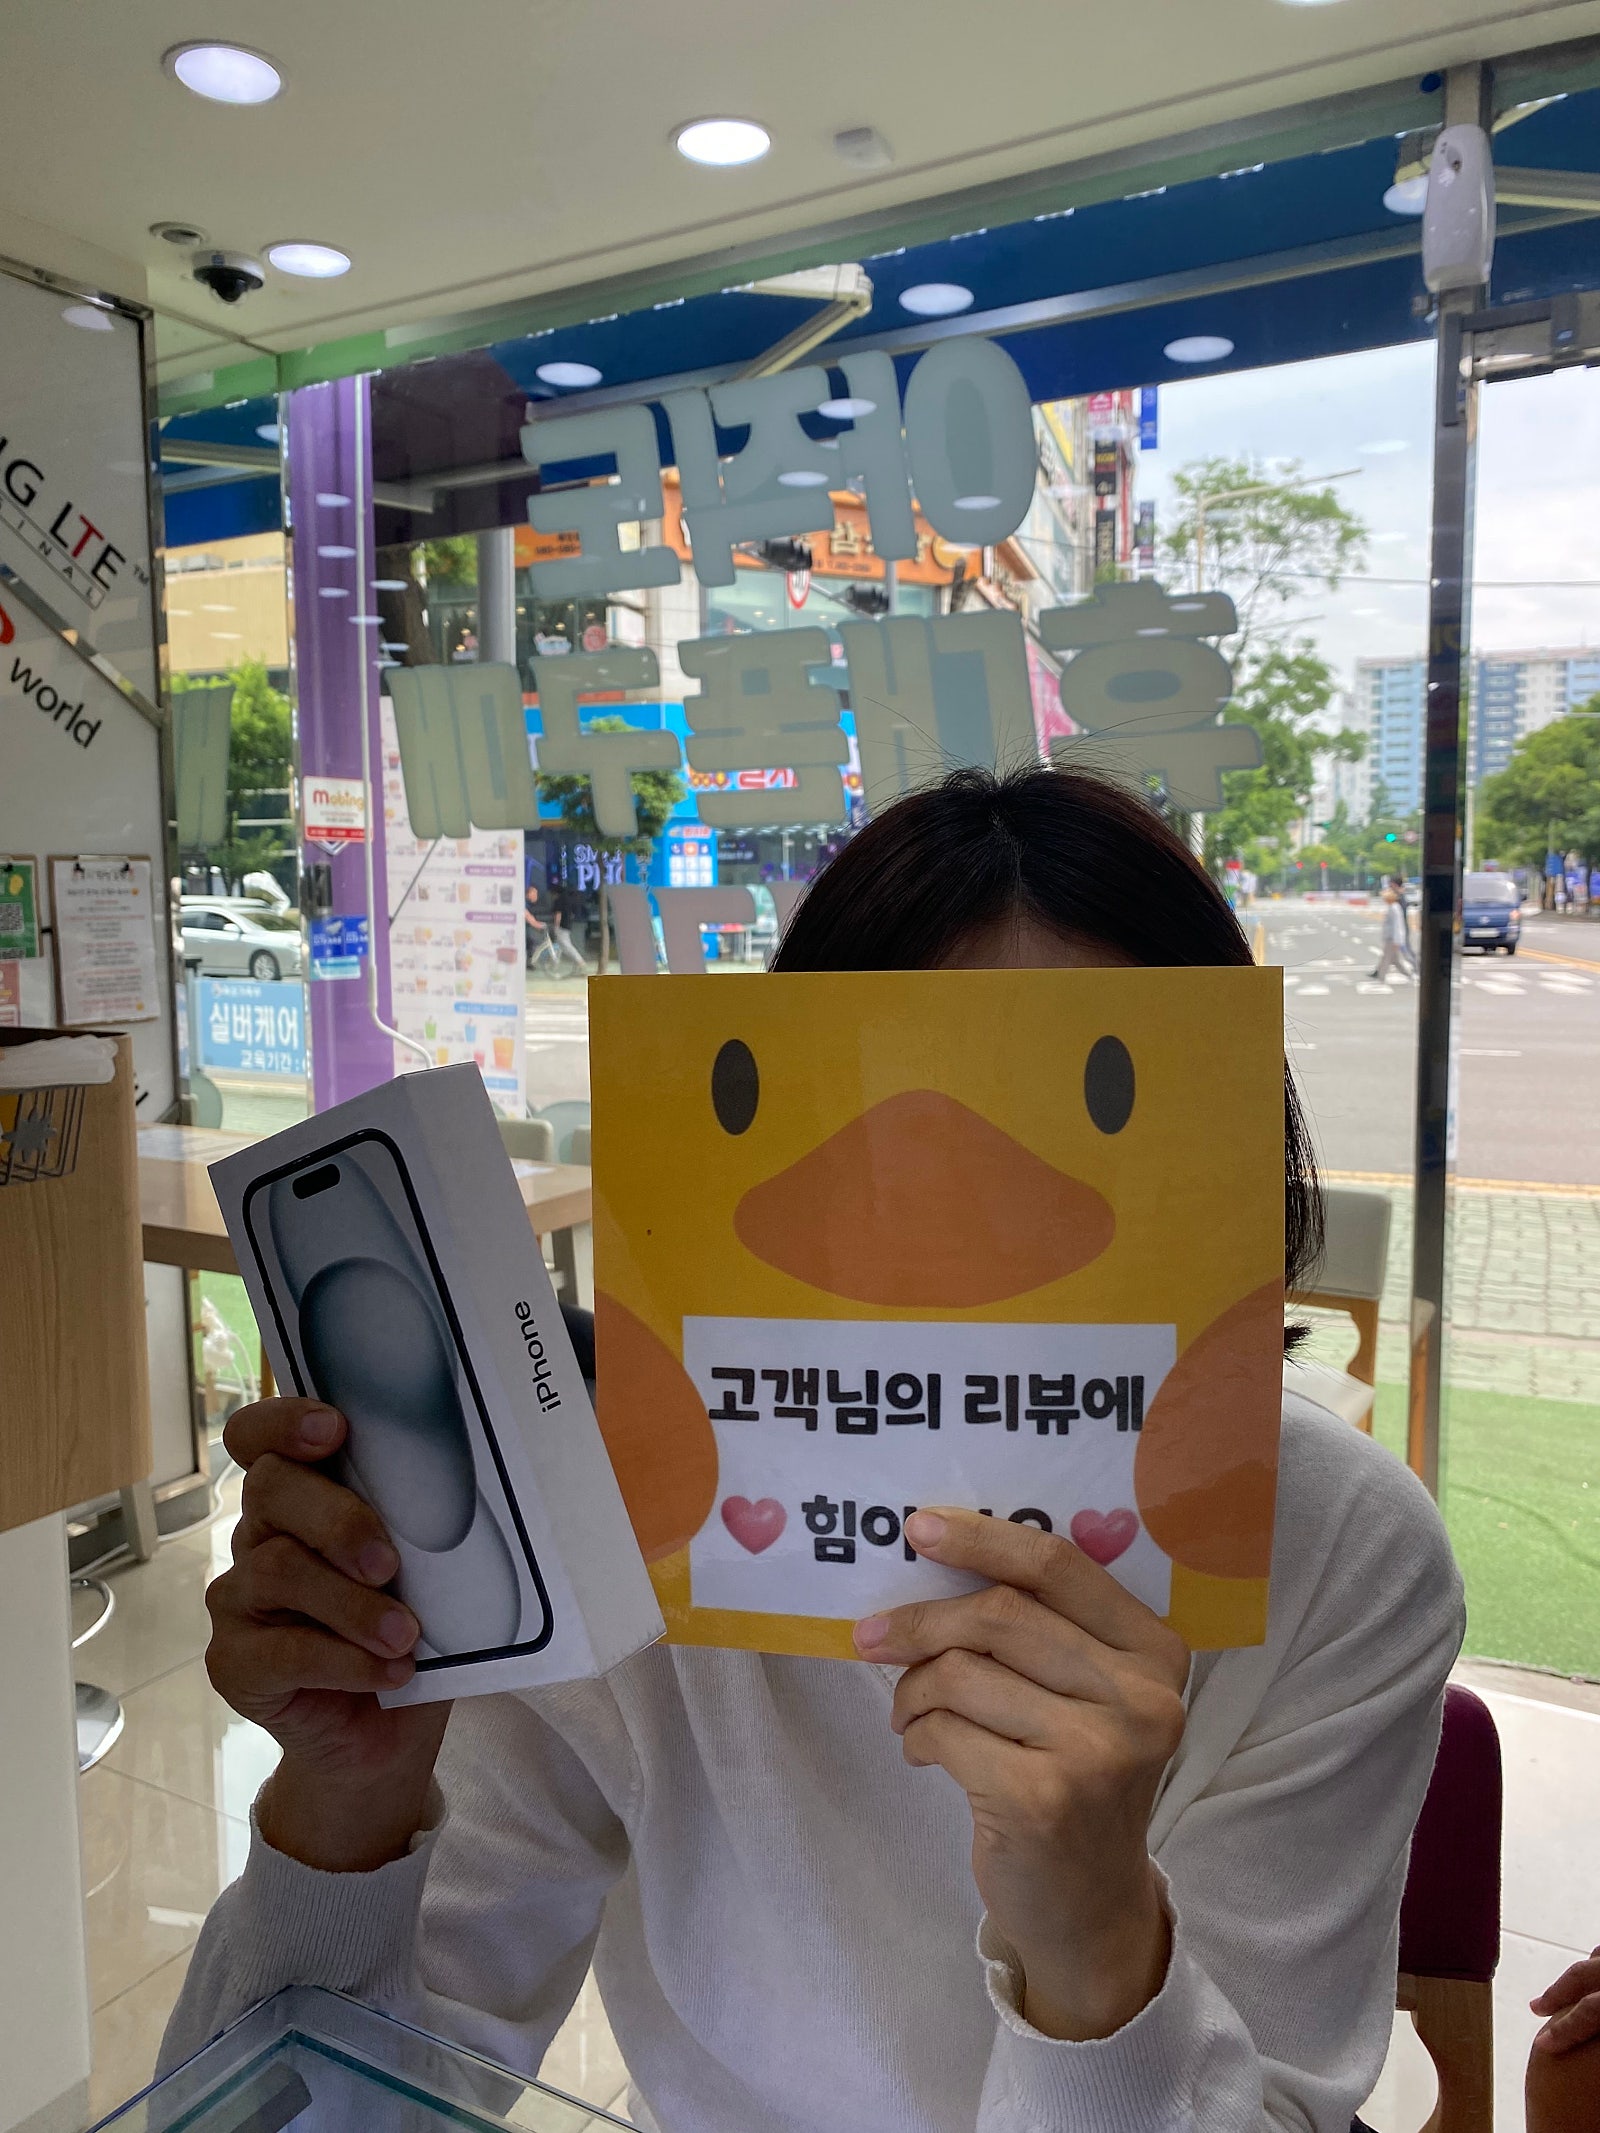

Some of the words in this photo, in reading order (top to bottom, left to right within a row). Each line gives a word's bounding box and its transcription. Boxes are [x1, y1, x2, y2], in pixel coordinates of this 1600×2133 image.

[50, 501, 127, 591] LTE
[11, 656, 103, 750] world
[209, 1002, 299, 1051] 실버케어
[514, 1300, 562, 1413] iPhone
[708, 1367, 941, 1435] 고객님의
[964, 1373, 1145, 1436] 리뷰에
[801, 1494, 918, 1565] 힘이
